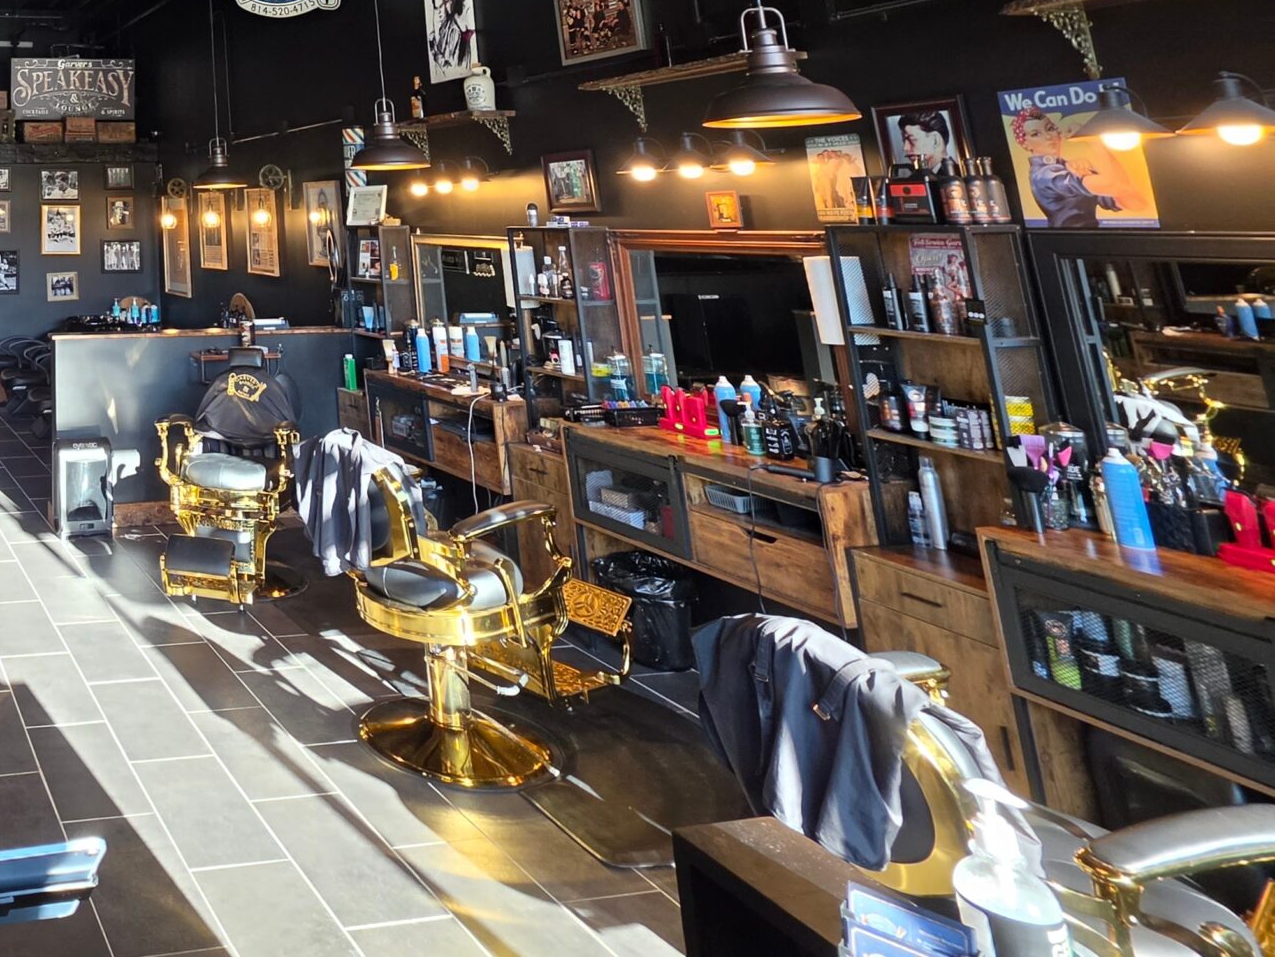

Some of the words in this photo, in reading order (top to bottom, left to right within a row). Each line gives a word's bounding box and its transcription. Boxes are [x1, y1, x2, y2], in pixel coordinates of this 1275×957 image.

[13, 69, 134, 108] SPEAKEASY
[55, 102, 94, 113] LOUNGE
[70, 93, 80, 104] &
[1004, 92, 1033, 111] We
[1033, 90, 1068, 108] Can
[1069, 86, 1097, 106] Do
